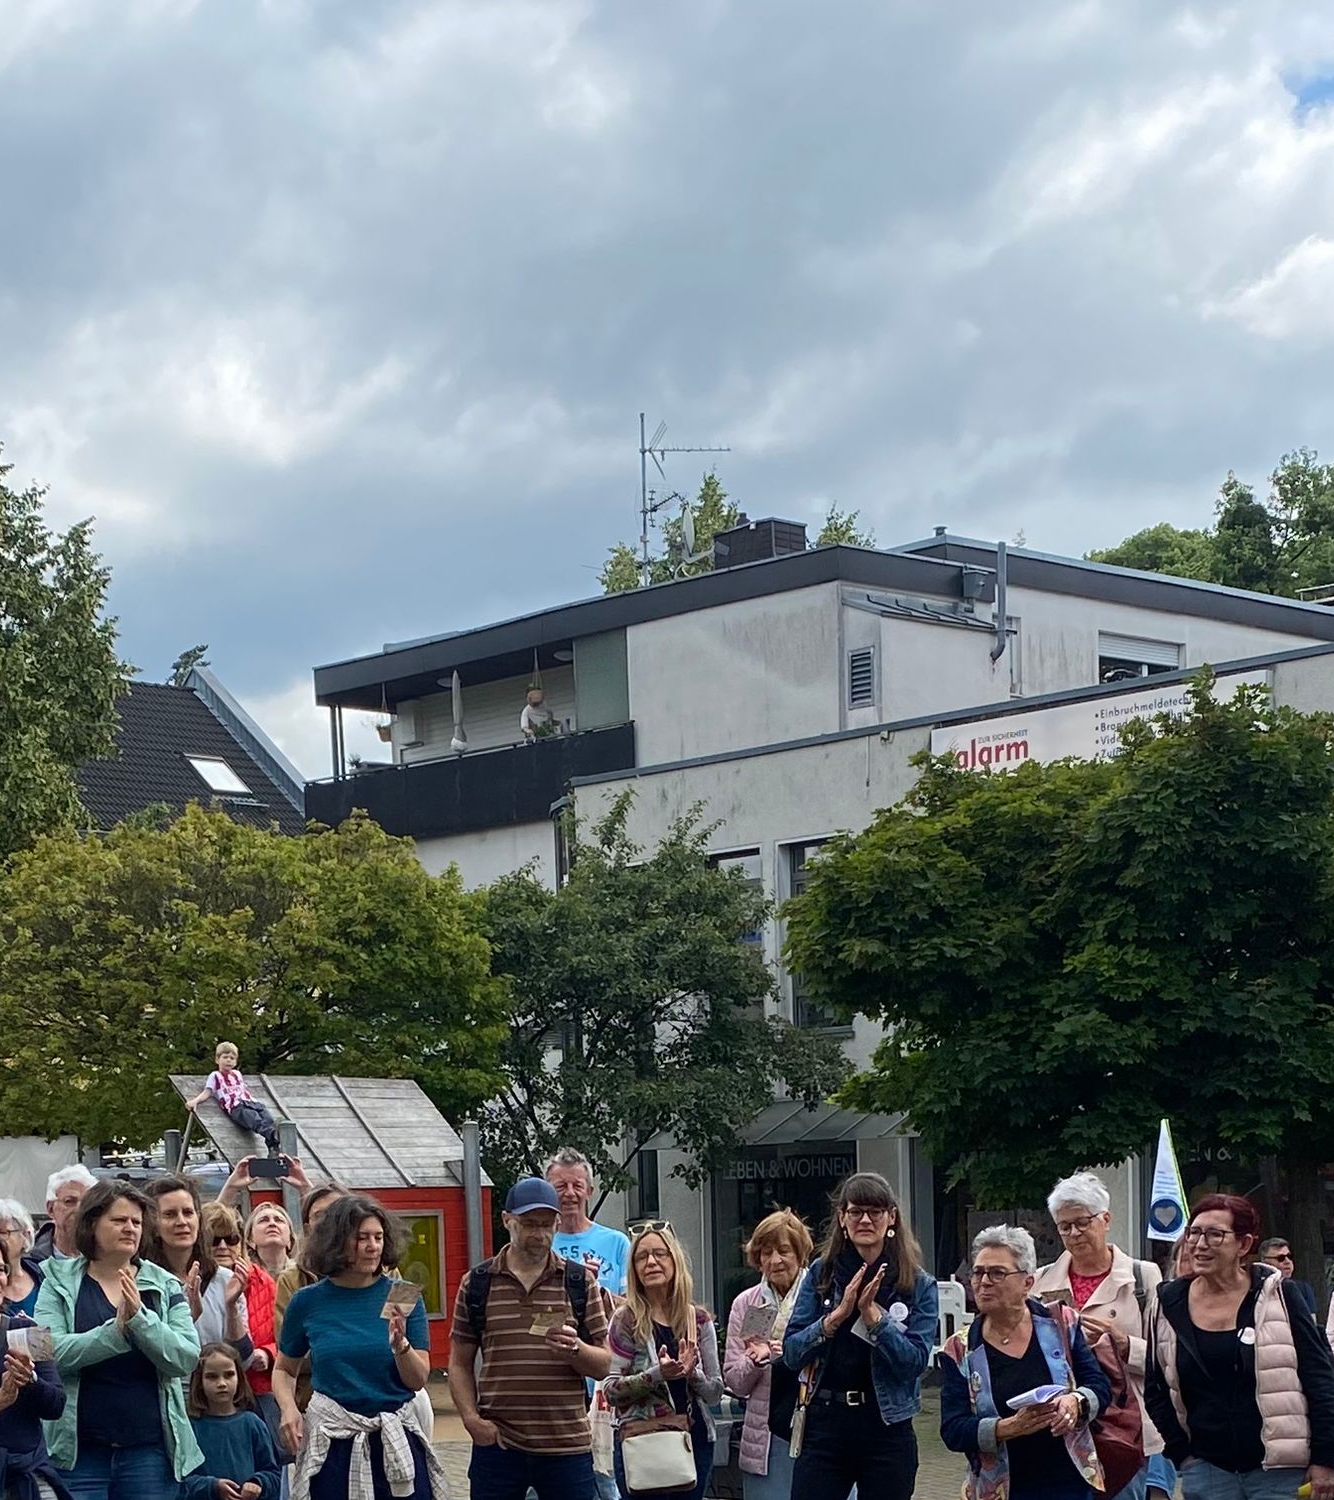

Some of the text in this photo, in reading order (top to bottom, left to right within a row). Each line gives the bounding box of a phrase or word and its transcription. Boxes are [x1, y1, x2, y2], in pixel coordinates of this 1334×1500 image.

[991, 729, 1028, 741] SICHERHEIT
[955, 738, 1029, 769] alarm
[769, 1160, 779, 1178] &
[783, 1157, 854, 1178] WOHNEN
